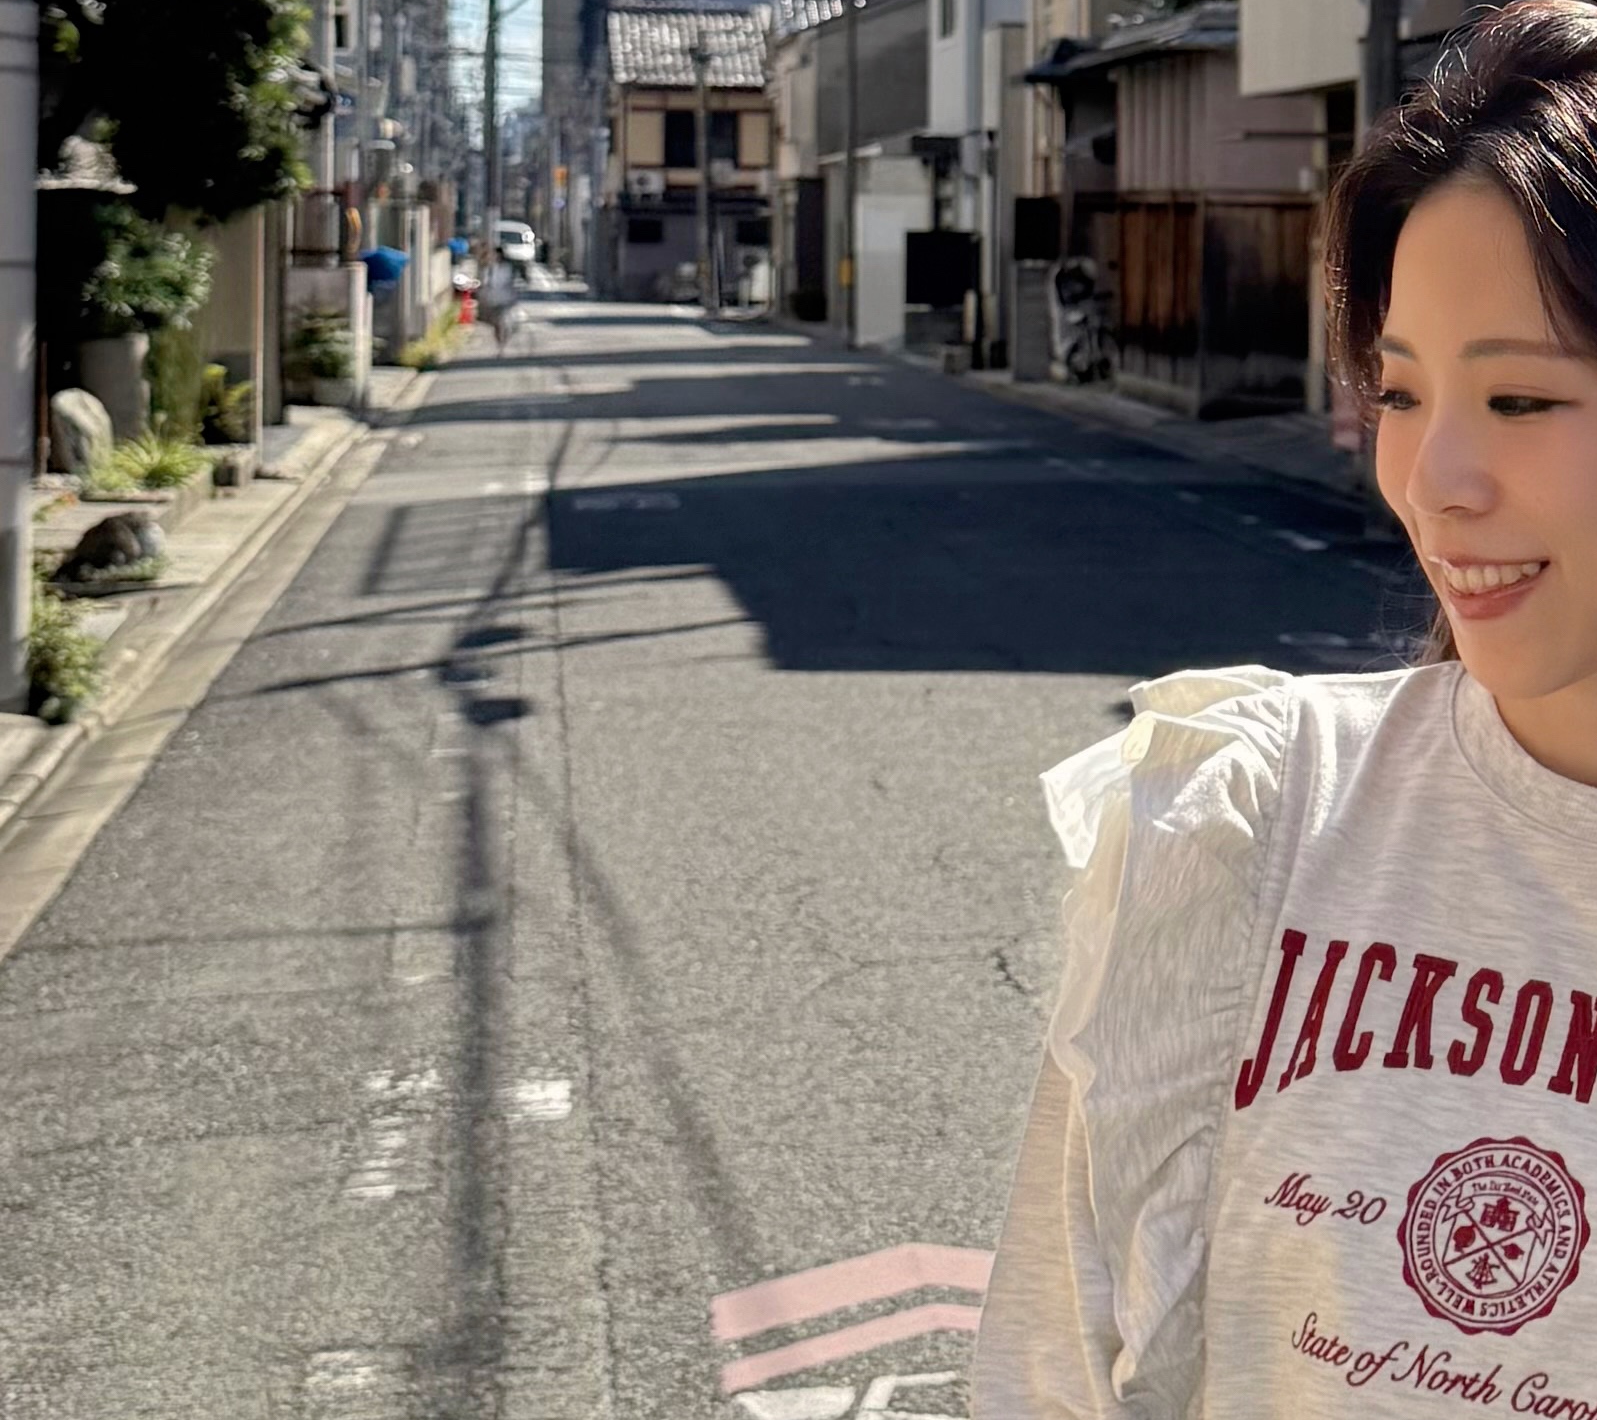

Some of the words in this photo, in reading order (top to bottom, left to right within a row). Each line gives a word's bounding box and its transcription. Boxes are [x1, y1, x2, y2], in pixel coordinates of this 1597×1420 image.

[1432, 1177, 1451, 1197] IN
[1450, 1154, 1495, 1179] BOTH
[1501, 1154, 1572, 1219] ACADEMICS
[1263, 1172, 1332, 1226] May
[1331, 1189, 1387, 1225] 20
[1557, 1225, 1572, 1259] AND
[1480, 1263, 1560, 1318] ATHLETICS
[1291, 1312, 1353, 1366] State
[1346, 1340, 1407, 1387] of
[1391, 1344, 1503, 1405] North
